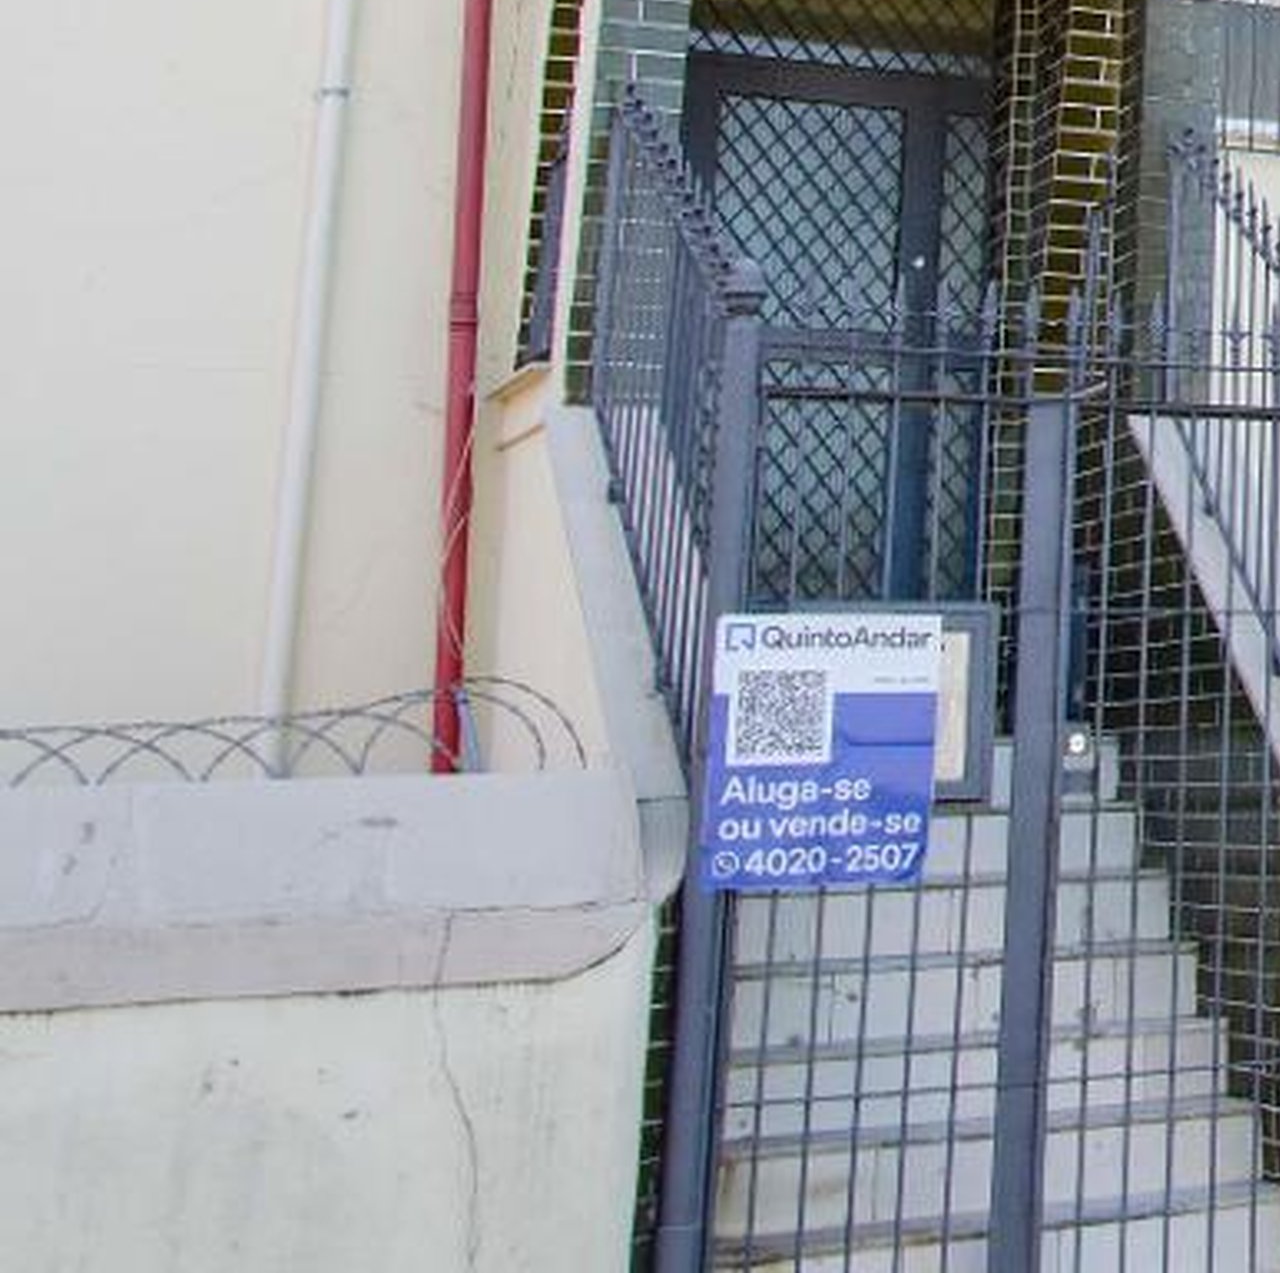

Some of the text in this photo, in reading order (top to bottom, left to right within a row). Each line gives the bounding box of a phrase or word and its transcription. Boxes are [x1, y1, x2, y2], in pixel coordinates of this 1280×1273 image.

[762, 626, 932, 651] QuintoAndar
[721, 776, 872, 809] Aluga-se
[718, 809, 921, 840] ou vende-se
[744, 844, 919, 876] 4020-2507
